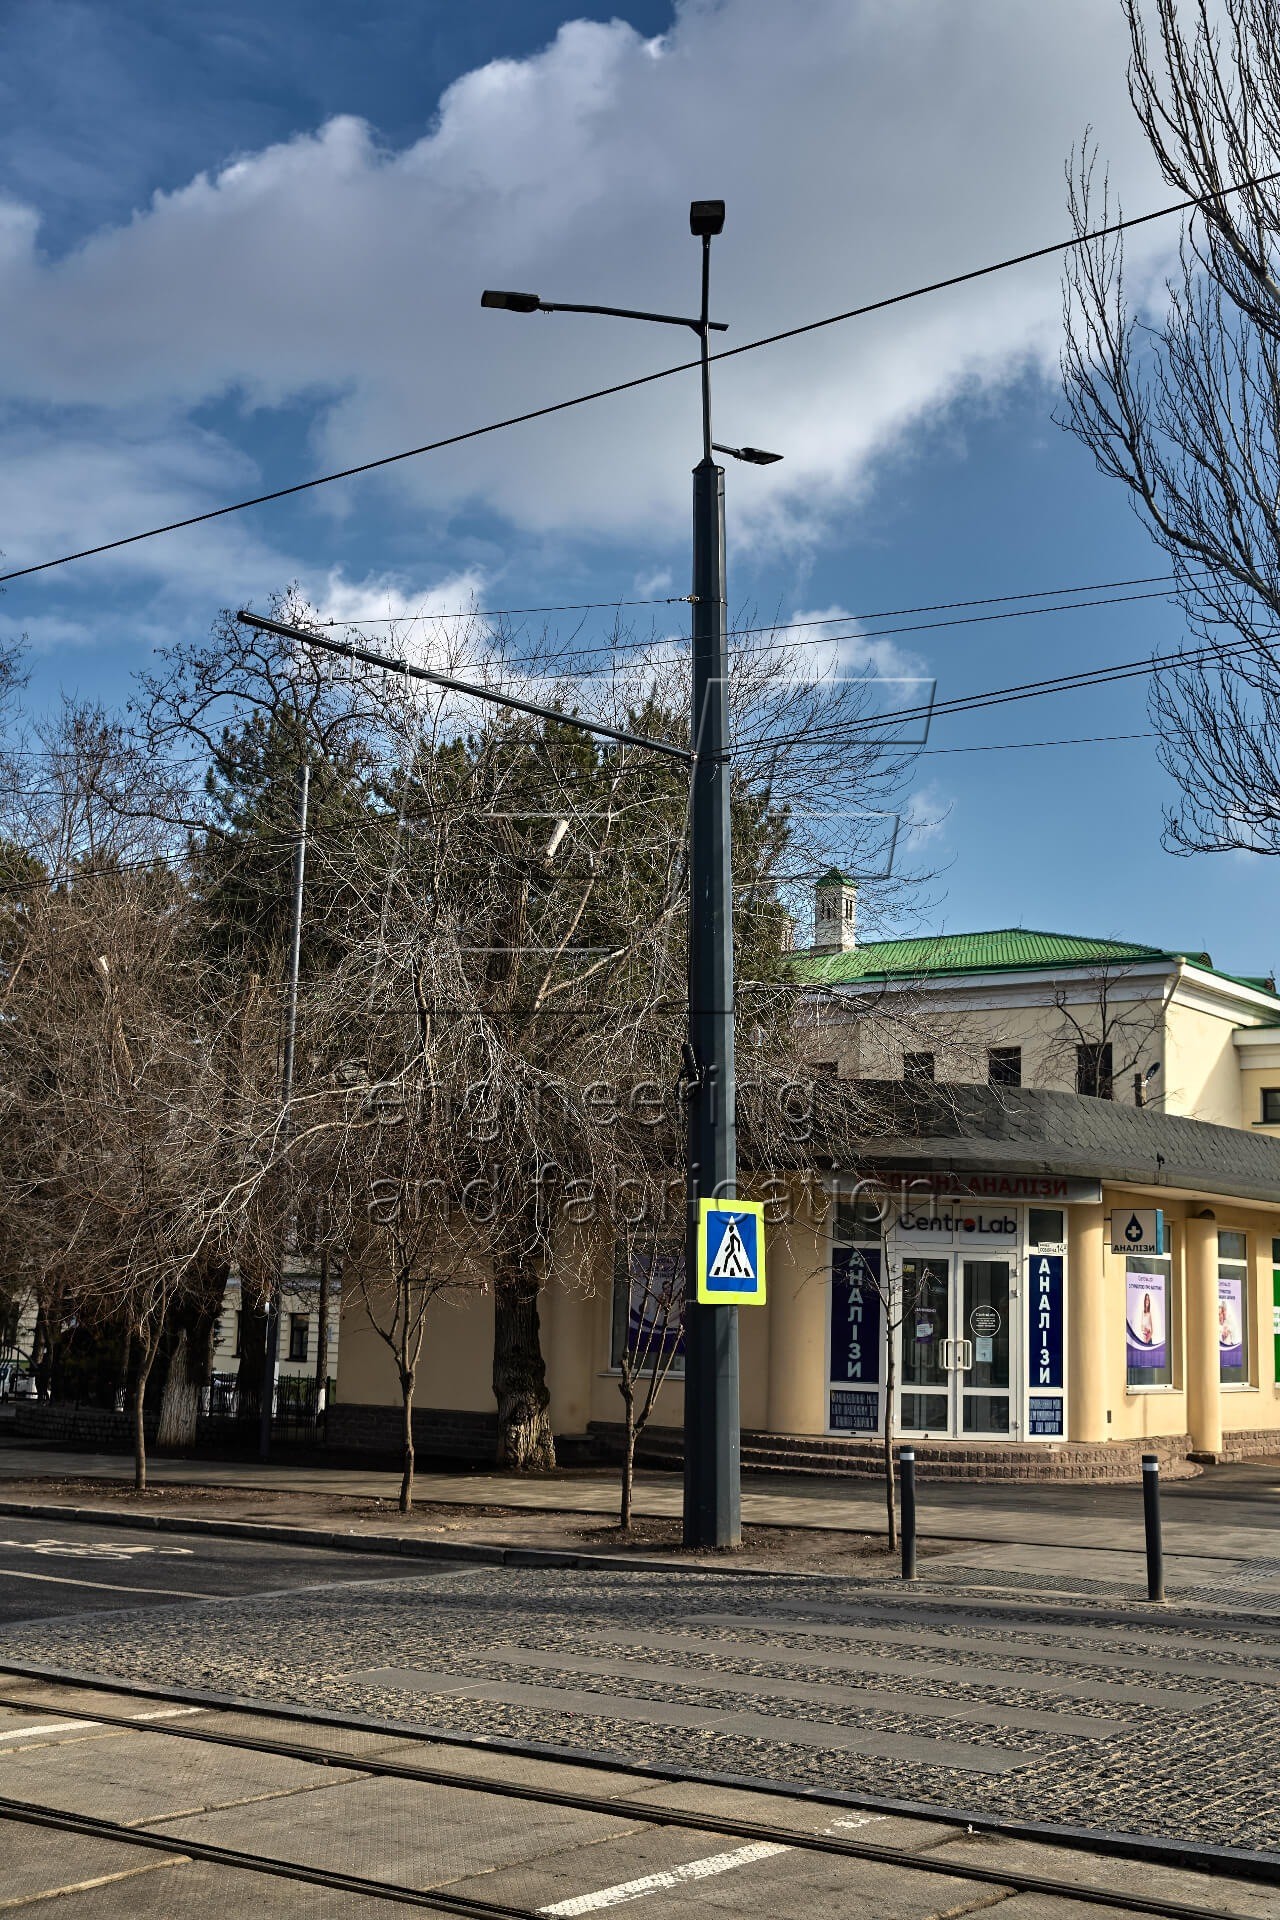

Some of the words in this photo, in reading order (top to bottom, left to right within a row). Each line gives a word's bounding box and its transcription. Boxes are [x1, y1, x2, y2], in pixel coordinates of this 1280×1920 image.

[967, 1175, 1068, 1196] АНАЛІЗИ
[1113, 1244, 1155, 1253] АНАЛІЗИ
[847, 1251, 864, 1378] АНАЛІЗИ
[1038, 1258, 1051, 1384] АНАЛІЗИ
